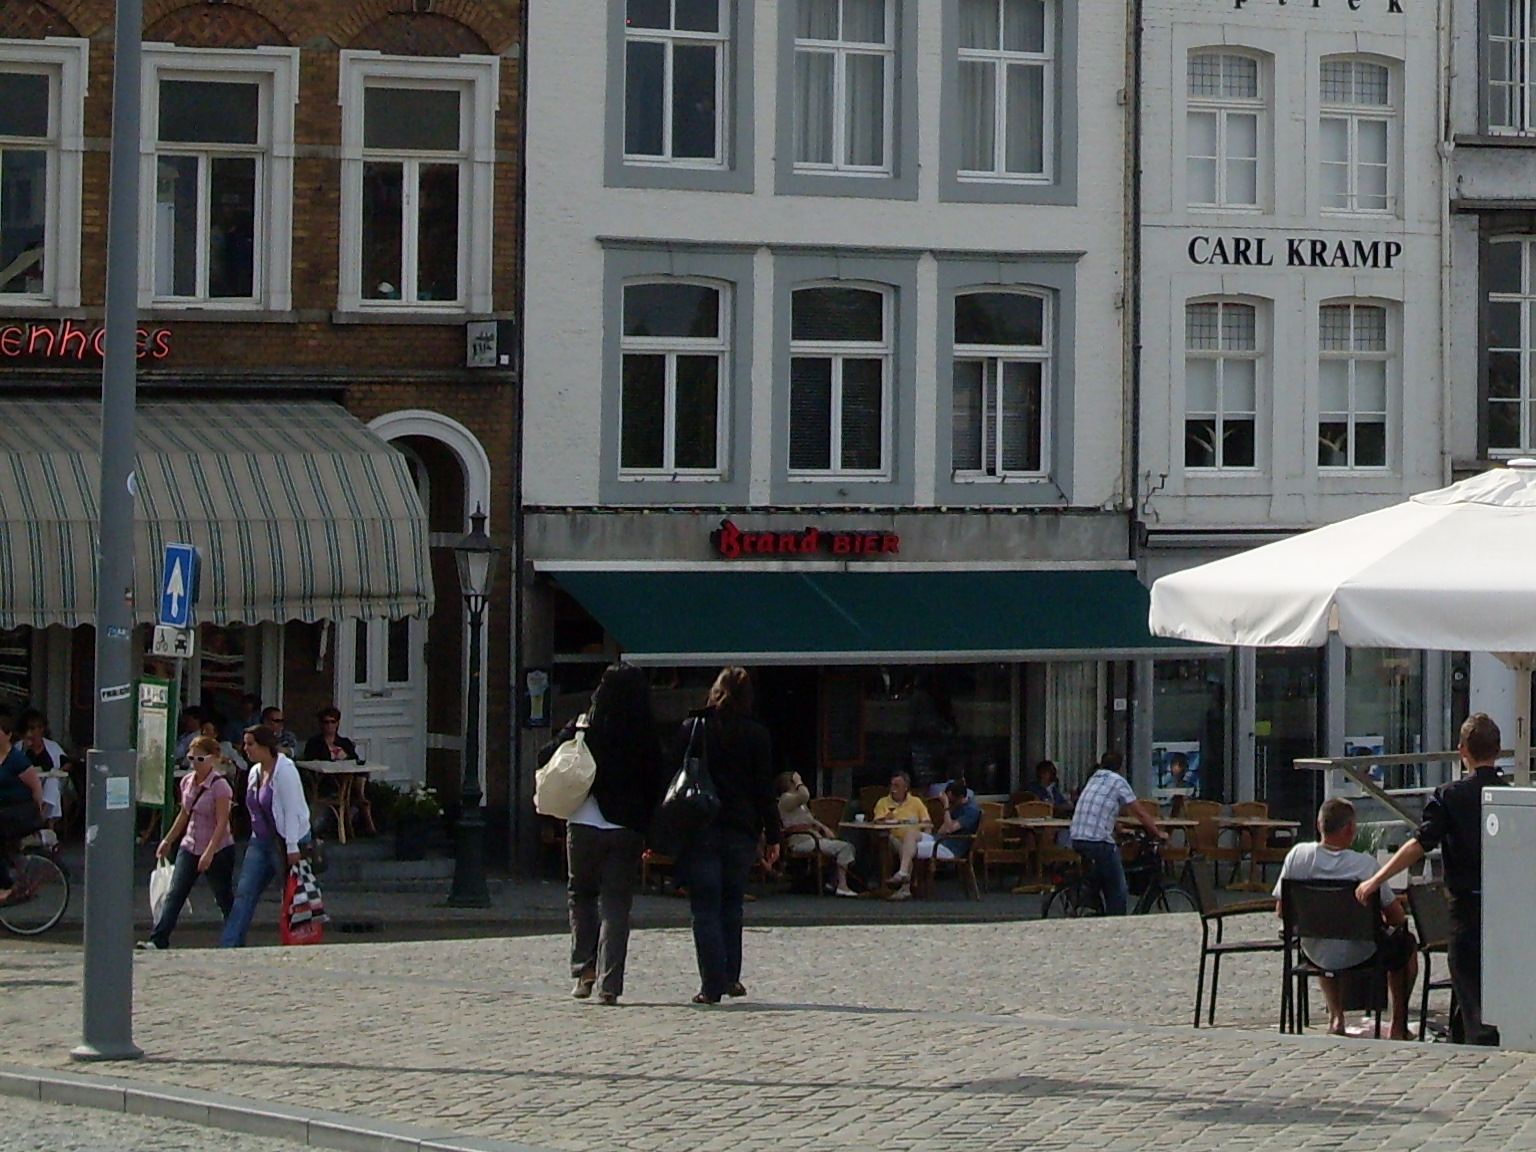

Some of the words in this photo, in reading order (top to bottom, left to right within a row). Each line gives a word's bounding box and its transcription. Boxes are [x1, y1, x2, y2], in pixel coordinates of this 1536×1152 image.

[1187, 235, 1274, 266] CARL
[1286, 238, 1402, 269] KRAMP
[716, 518, 820, 559] Brand
[833, 533, 901, 554] BIER
